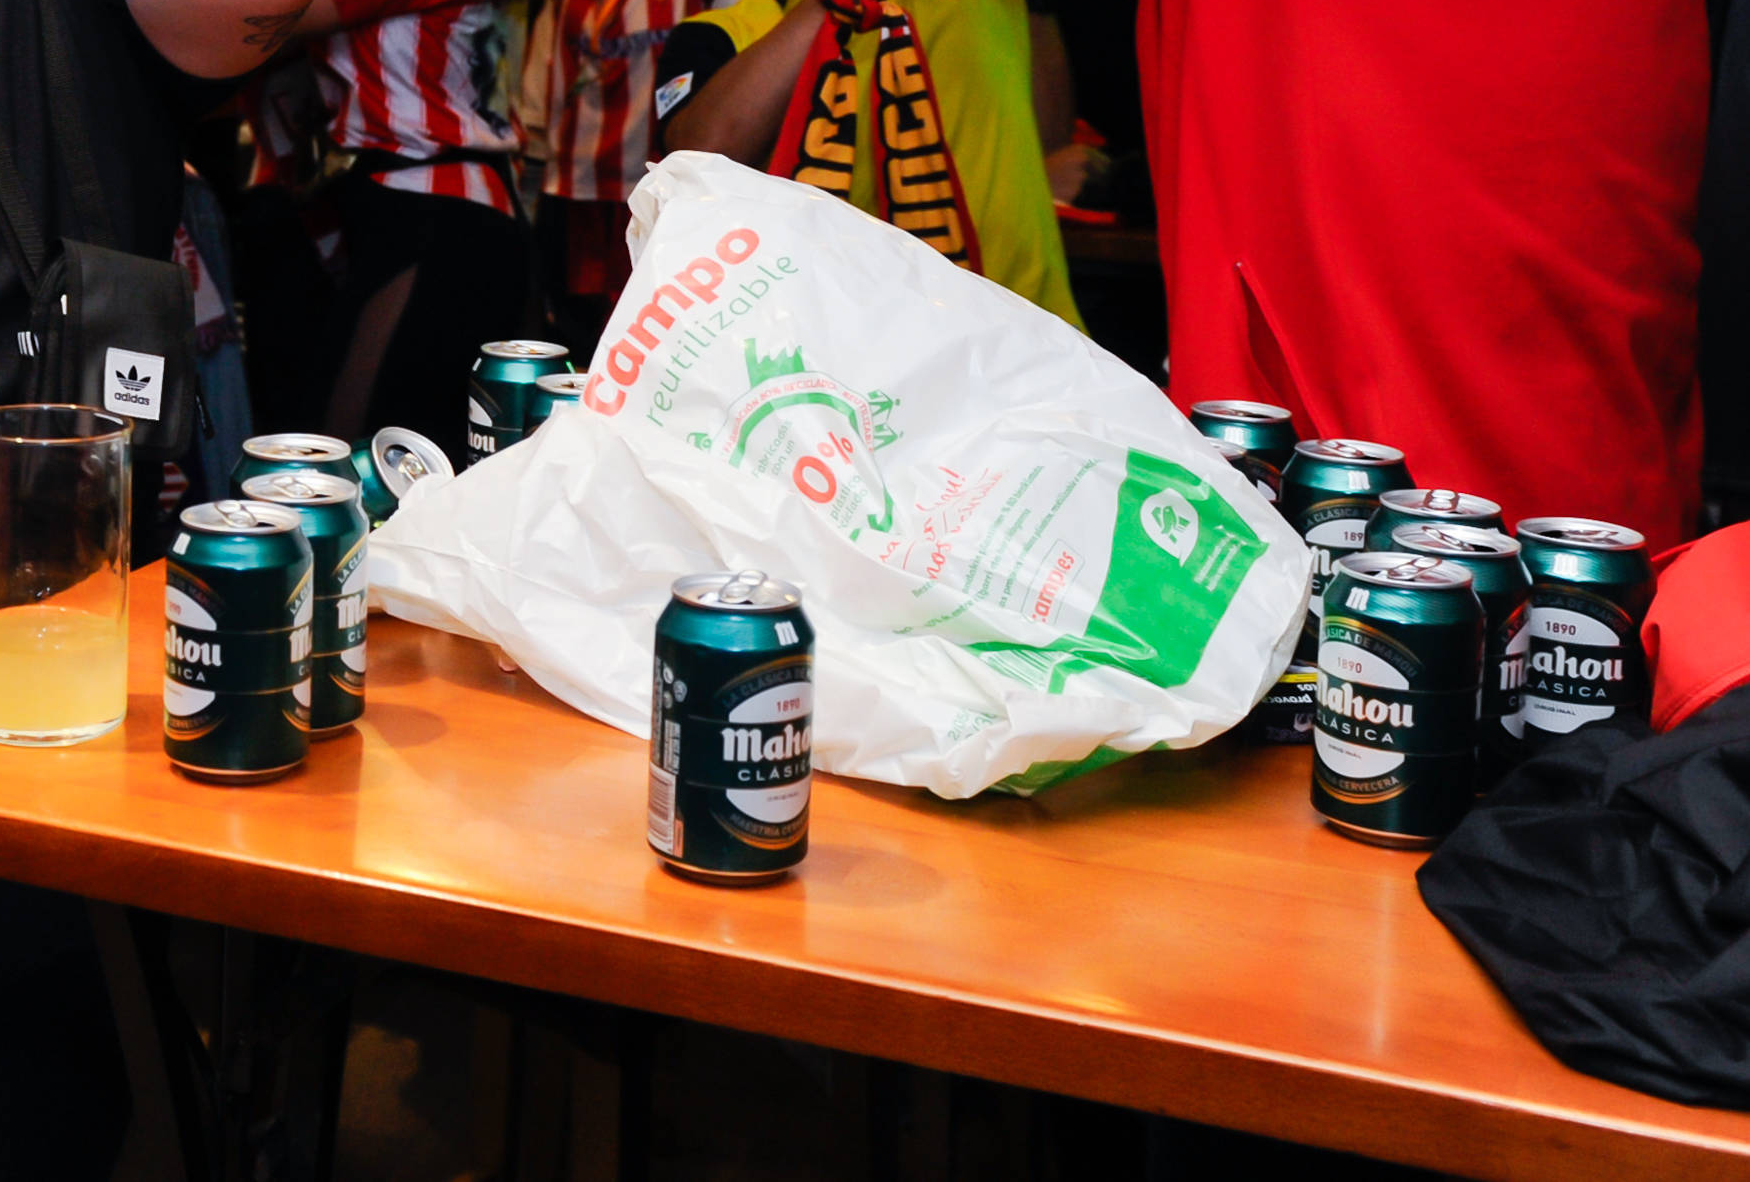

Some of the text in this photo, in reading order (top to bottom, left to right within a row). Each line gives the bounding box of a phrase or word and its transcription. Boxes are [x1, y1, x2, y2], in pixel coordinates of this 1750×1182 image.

[879, 45, 971, 271] UNCA
[646, 256, 800, 428] reutilizable
[114, 392, 151, 406] adidas
[1343, 530, 1365, 543] 189
[1545, 620, 1577, 637] 1890
[1337, 656, 1363, 675] 1890
[1531, 645, 1624, 682] ahou
[776, 696, 801, 715] 1890
[720, 723, 813, 763] Maho
